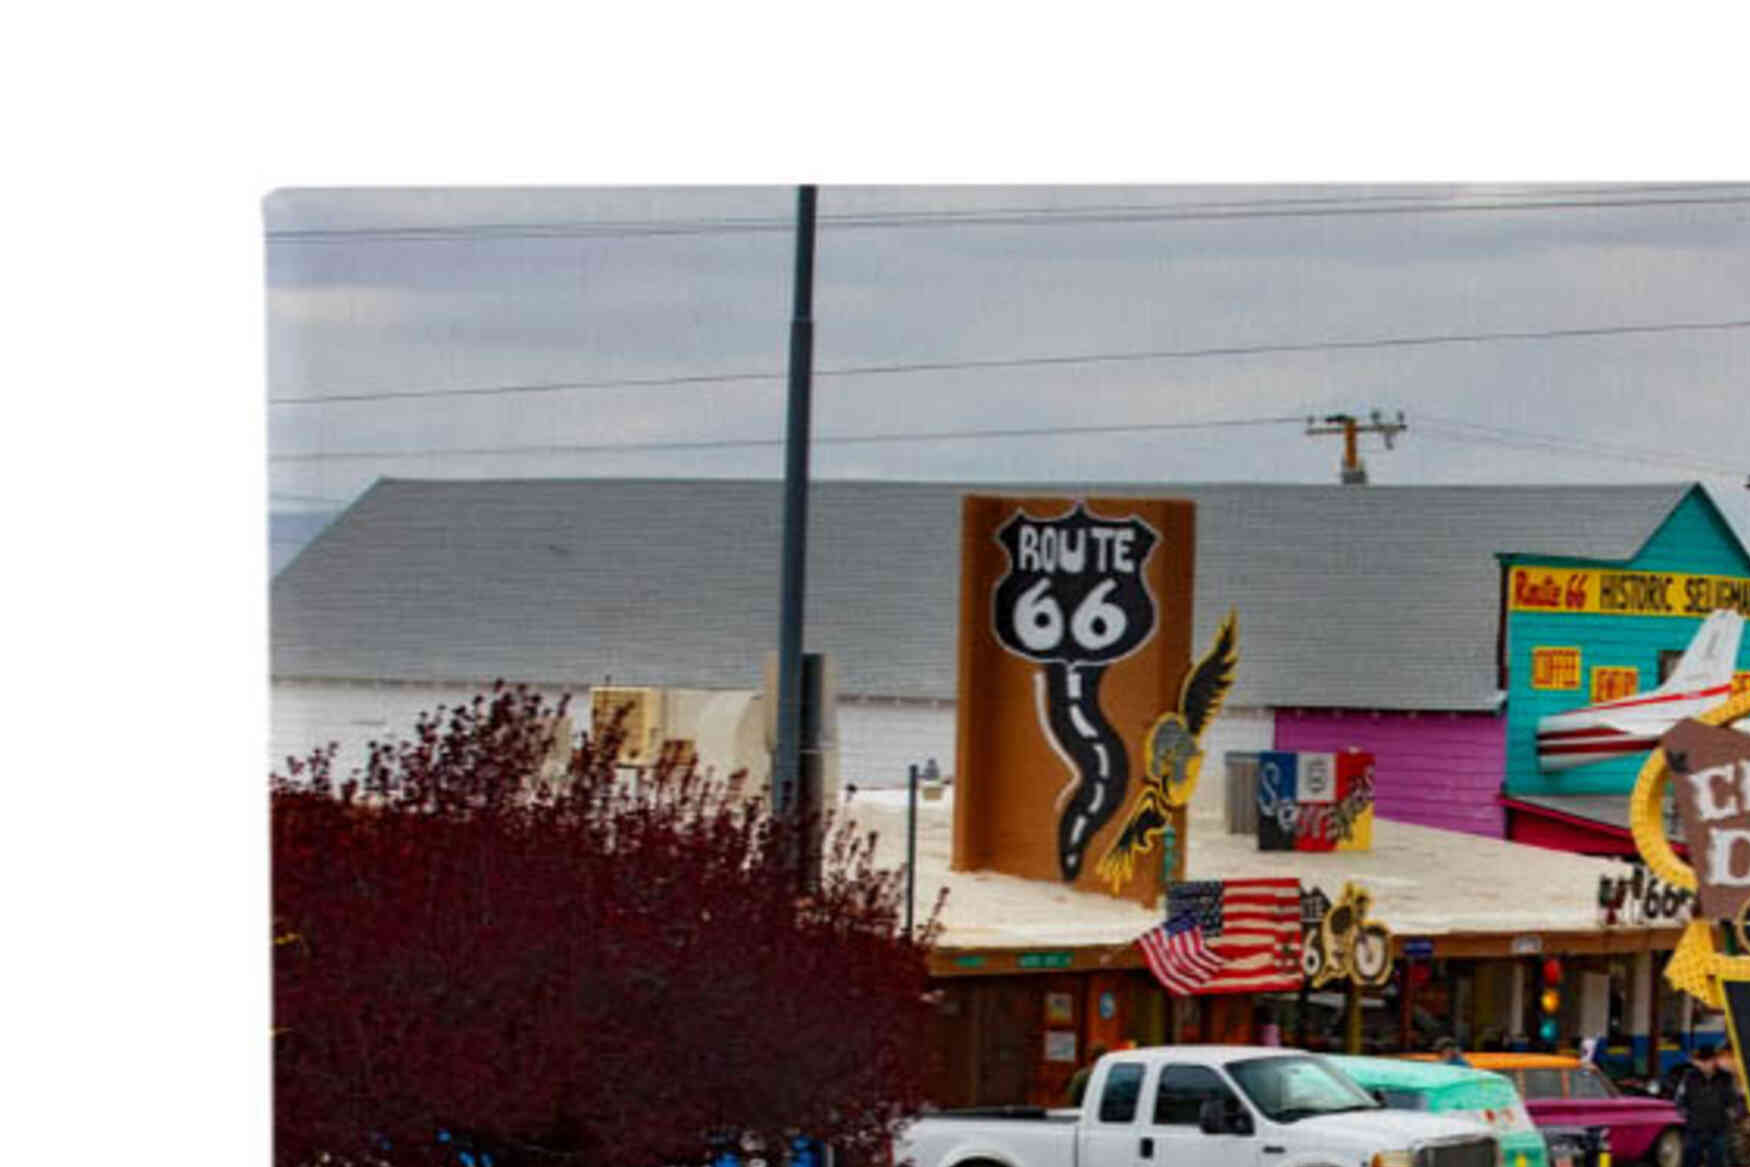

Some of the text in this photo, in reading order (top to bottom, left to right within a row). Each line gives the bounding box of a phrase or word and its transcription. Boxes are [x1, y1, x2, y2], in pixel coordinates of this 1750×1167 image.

[1017, 524, 1135, 573] ROUTE
[1013, 578, 1127, 650] 66
[1565, 573, 1588, 610] 66
[1600, 574, 1673, 612] HISTORIC
